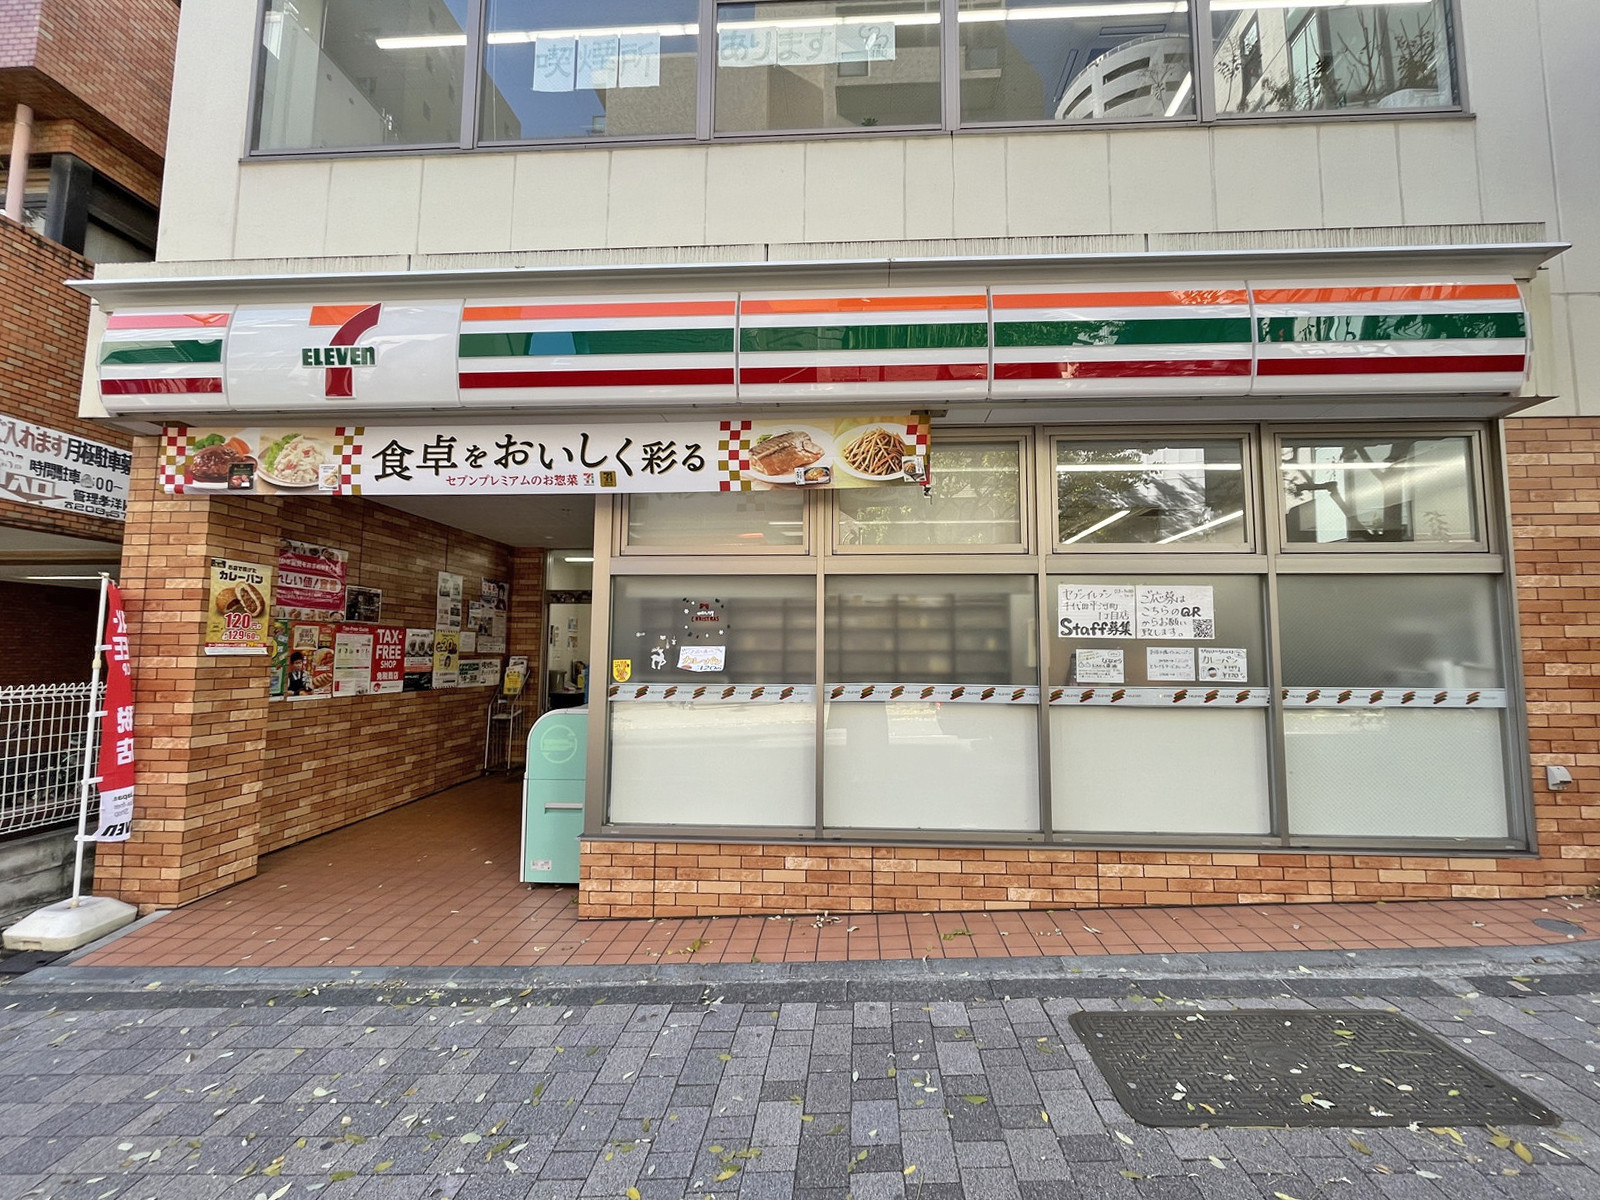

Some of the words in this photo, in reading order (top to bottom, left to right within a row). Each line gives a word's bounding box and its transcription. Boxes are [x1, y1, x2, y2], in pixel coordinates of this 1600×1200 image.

[536, 38, 653, 78] 喫煙所
[720, 27, 832, 61] あります
[0, 419, 67, 458] 入れます
[371, 432, 706, 482] 食卓をおいしく彩る
[445, 473, 579, 487] セブンプレミアムのお惣菜
[219, 570, 264, 584] カレーパン
[1062, 600, 1119, 611] 千代田平河町
[1141, 605, 1202, 618] こちらのQR
[1060, 617, 1133, 636] Staff募集
[1141, 617, 1188, 627] からお願い
[376, 628, 403, 644] TAX-
[375, 644, 402, 660] FREE
[380, 660, 397, 669] SHOP
